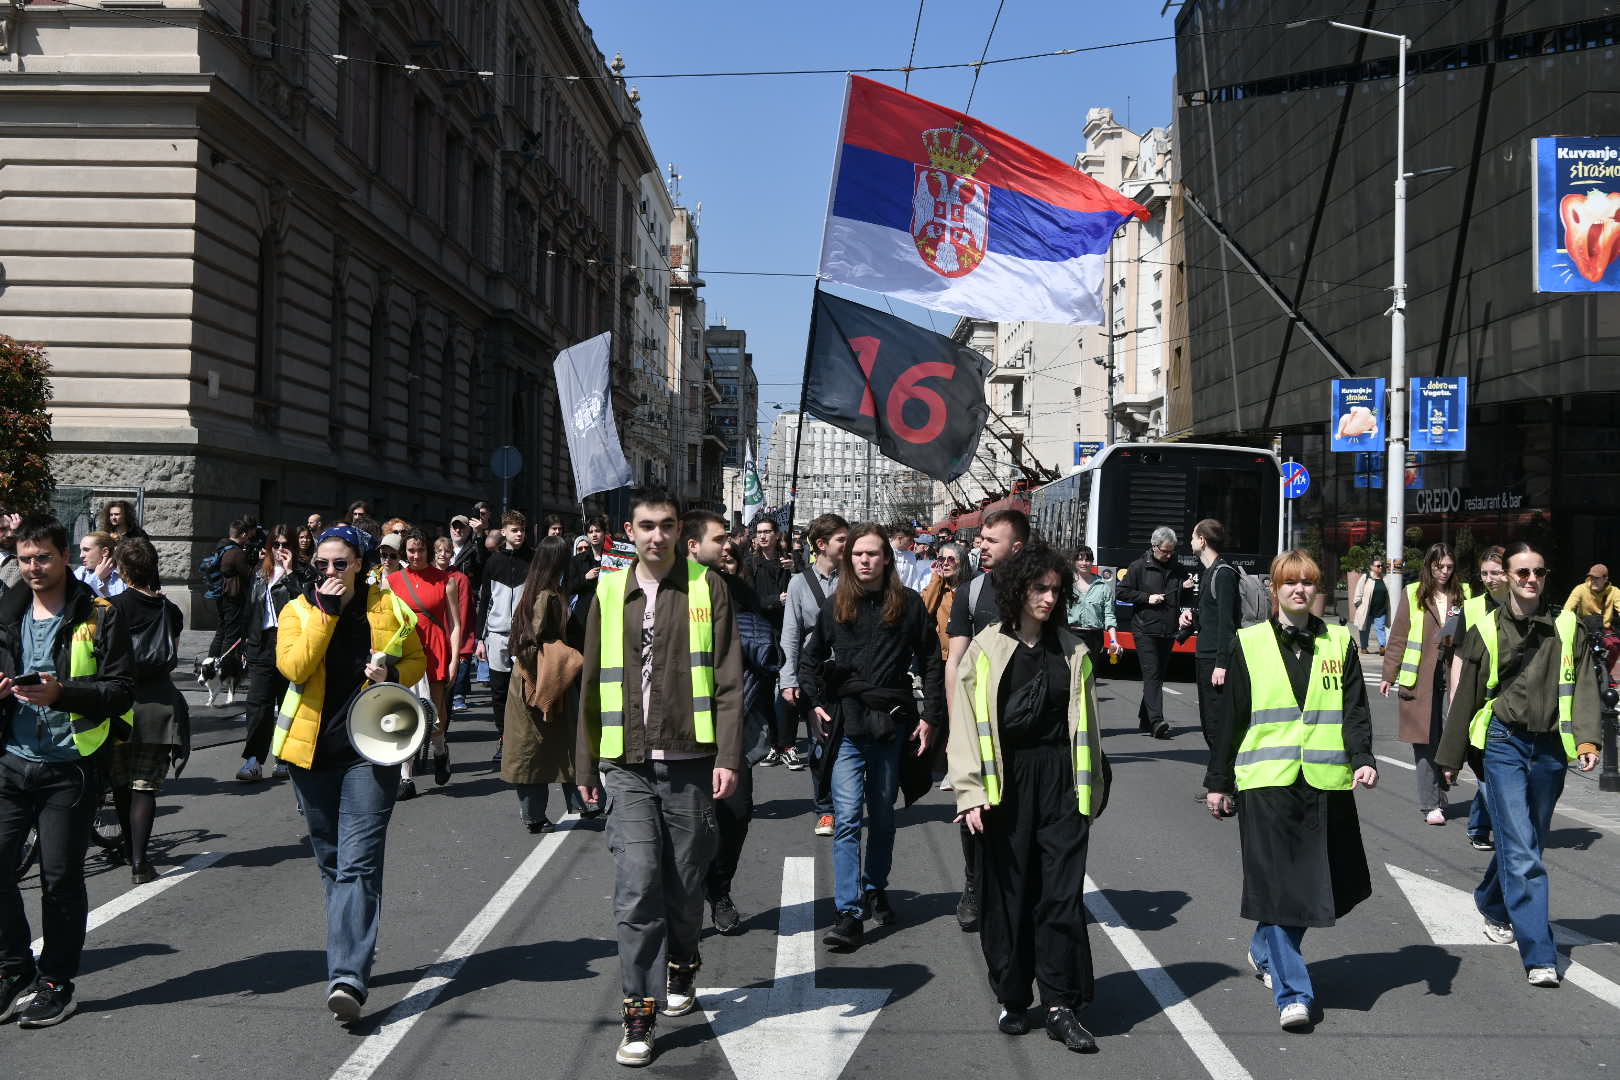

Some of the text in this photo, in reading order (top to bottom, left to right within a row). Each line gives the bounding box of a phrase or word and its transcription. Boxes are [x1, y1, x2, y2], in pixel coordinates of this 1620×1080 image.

[1557, 146, 1617, 160] Kuvanje
[848, 335, 957, 445] 16
[1416, 488, 1522, 513] CREDO restaurant & bar
